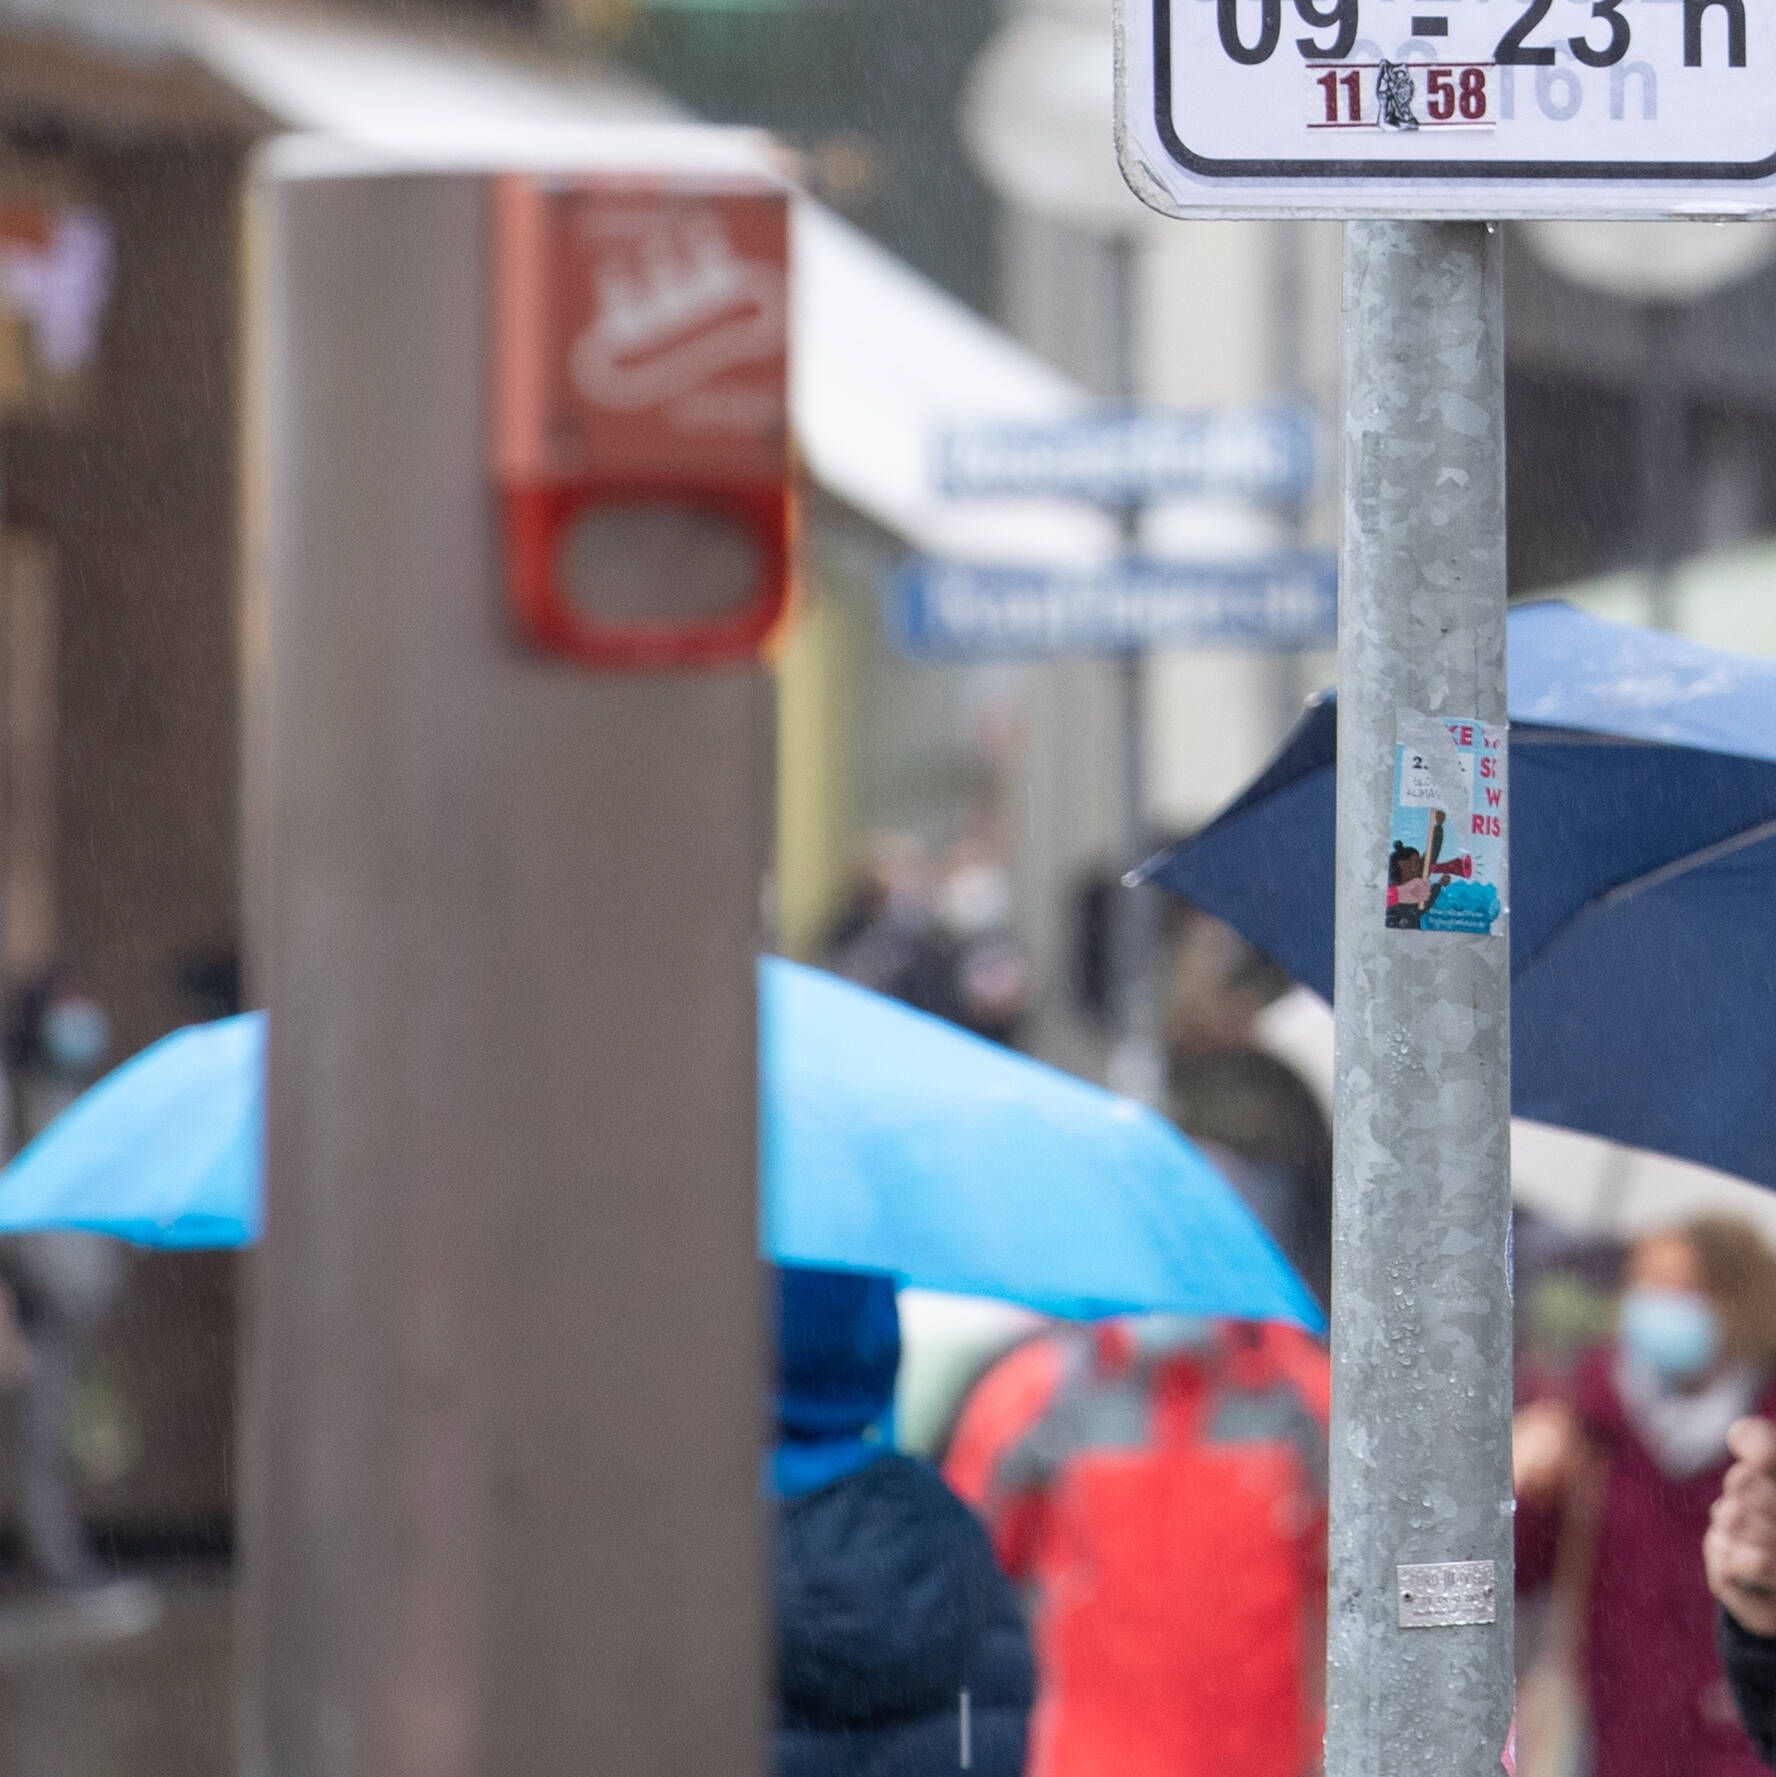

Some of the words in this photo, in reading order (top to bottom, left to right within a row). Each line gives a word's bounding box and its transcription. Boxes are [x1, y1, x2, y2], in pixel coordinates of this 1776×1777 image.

[1412, 16, 1448, 37] -
[1317, 70, 1361, 122] 11
[1427, 68, 1486, 121] 58
